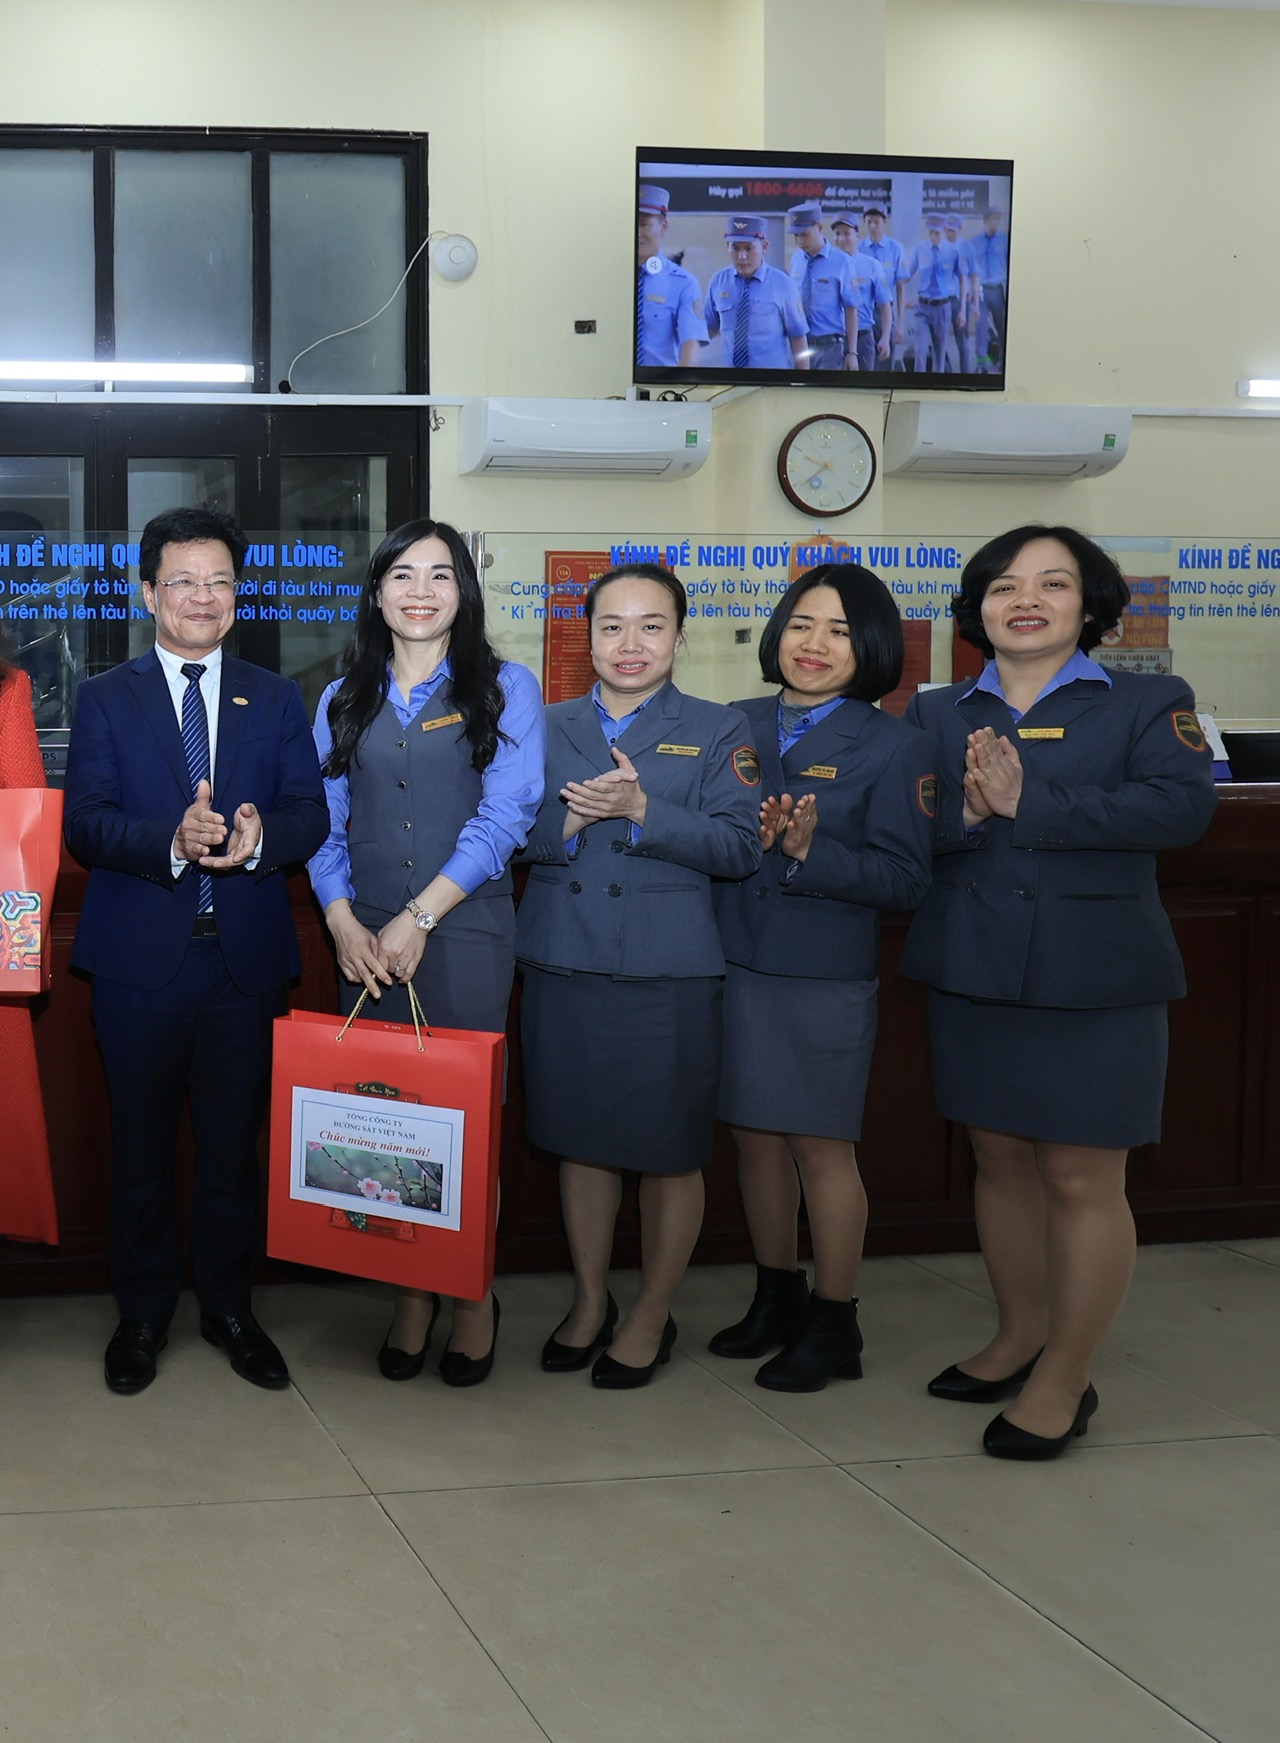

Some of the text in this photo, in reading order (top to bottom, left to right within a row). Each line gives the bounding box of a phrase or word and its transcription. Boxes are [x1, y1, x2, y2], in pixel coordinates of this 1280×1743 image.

[16, 536, 45, 566] ĐỀ
[52, 544, 104, 571] NGHỊ
[282, 539, 344, 567] LÒNG:
[610, 539, 962, 571] KÍNH ĐỀ NGHỊ QUÝ KHÁCH VUI LÒNG:
[1179, 544, 1222, 569] KÍNH
[1228, 543, 1252, 569] ĐỀ
[10, 579, 51, 598] hoặc
[56, 577, 90, 599] giấy
[94, 578, 110, 595] tờ
[114, 578, 138, 598] tùy
[262, 580, 277, 596] đi
[281, 579, 305, 596] tàu
[310, 581, 332, 596] khi
[510, 581, 550, 599] Cung
[686, 578, 717, 597] giấy
[722, 579, 736, 594] tờ
[740, 579, 761, 597] tùy
[765, 580, 791, 594] thâ
[891, 580, 913, 594] tàu
[917, 581, 937, 594] khi
[1160, 580, 1206, 595] CMTND
[1210, 581, 1244, 598] hoặc
[1248, 579, 1276, 598] giấy
[8, 604, 39, 619] trên
[43, 602, 68, 620] thẻ
[73, 604, 97, 620] lên
[100, 603, 126, 620] tàu
[260, 603, 292, 620] khỏi
[702, 604, 723, 617] lên
[727, 603, 750, 617] tàu
[754, 601, 773, 617] hỏ
[905, 601, 941, 620] quầy
[1189, 604, 1204, 617] tin
[1208, 604, 1233, 617] trên
[1237, 602, 1258, 618] thẻ
[369, 1116, 392, 1126] CÔNG
[393, 1120, 404, 1128] TY
[319, 1130, 431, 1157] Chúc mừng năm mới!
[378, 1127, 396, 1137] VIỆT
[397, 1132, 416, 1140] NAM
